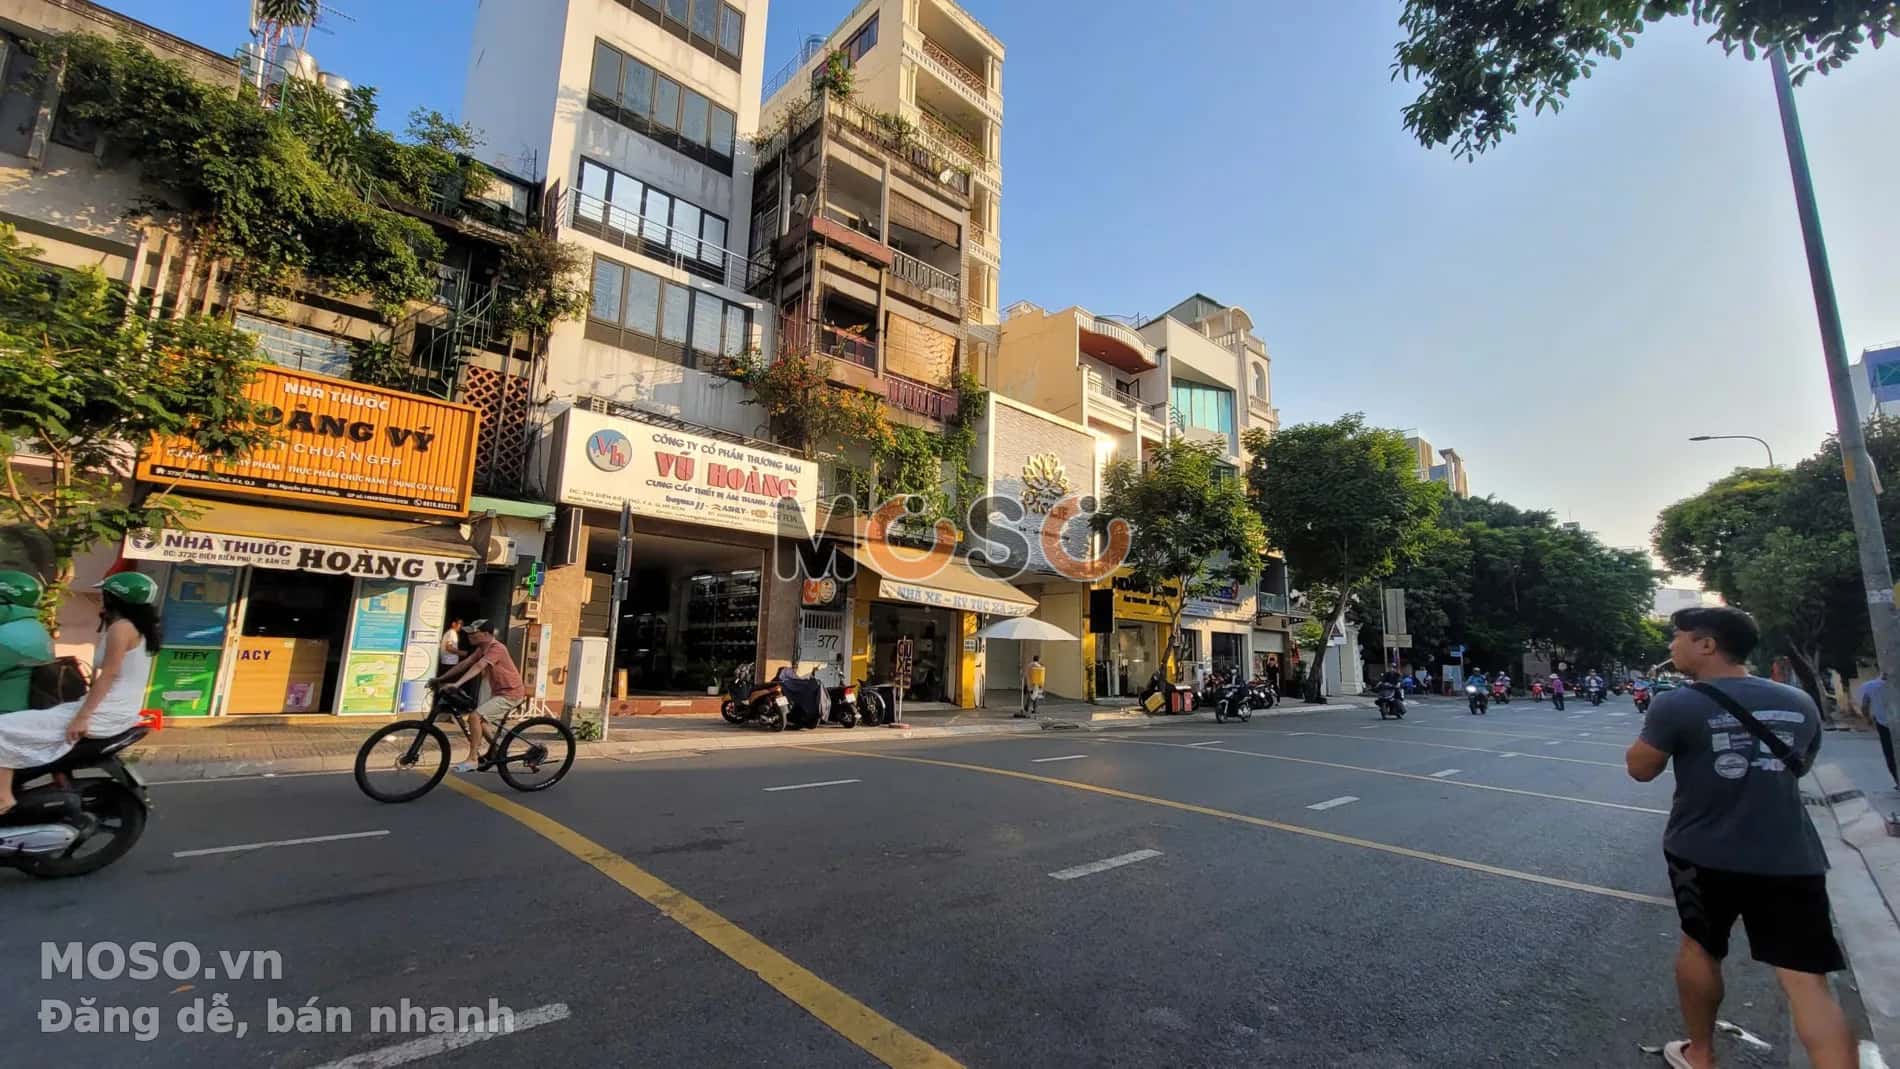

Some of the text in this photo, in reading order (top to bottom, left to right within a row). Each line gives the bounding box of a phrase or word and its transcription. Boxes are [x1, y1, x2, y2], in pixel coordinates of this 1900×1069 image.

[284, 382, 390, 411] NHÀ THUỐC
[250, 403, 375, 443] OÀNG
[366, 454, 403, 467] GPP
[652, 433, 685, 447] CÔNG
[687, 440, 698, 450] TY
[784, 463, 801, 474] MẠI
[646, 479, 673, 490] CUNG
[655, 451, 798, 499] VŨ HOÀNG
[165, 534, 214, 551] NHÀ
[223, 539, 293, 557] THUỐC
[297, 547, 424, 578] HOÀNG
[816, 634, 839, 650] 377
